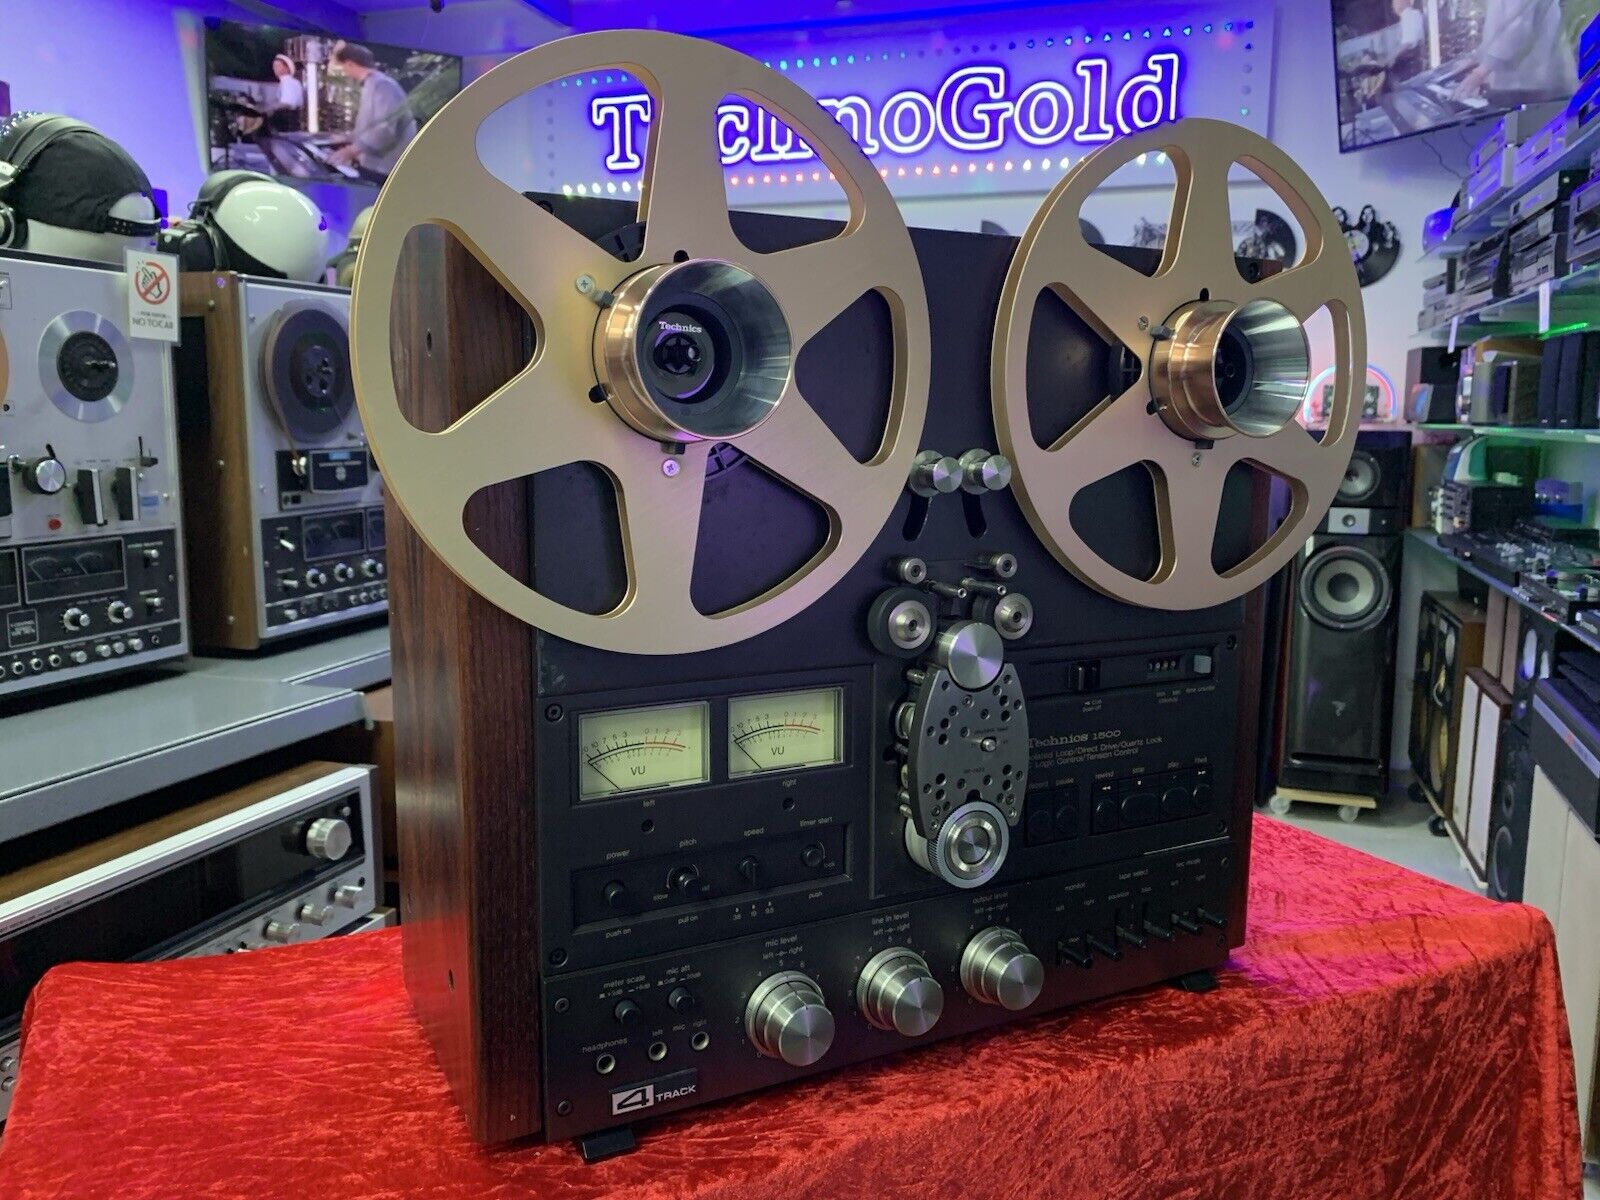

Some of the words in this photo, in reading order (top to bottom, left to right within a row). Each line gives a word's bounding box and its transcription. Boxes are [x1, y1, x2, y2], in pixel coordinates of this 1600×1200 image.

[591, 52, 1180, 171] TcnoGold
[658, 320, 702, 334] Technics
[771, 746, 785, 756] VU
[631, 765, 646, 776] VU
[656, 1084, 697, 1103] TRACK
